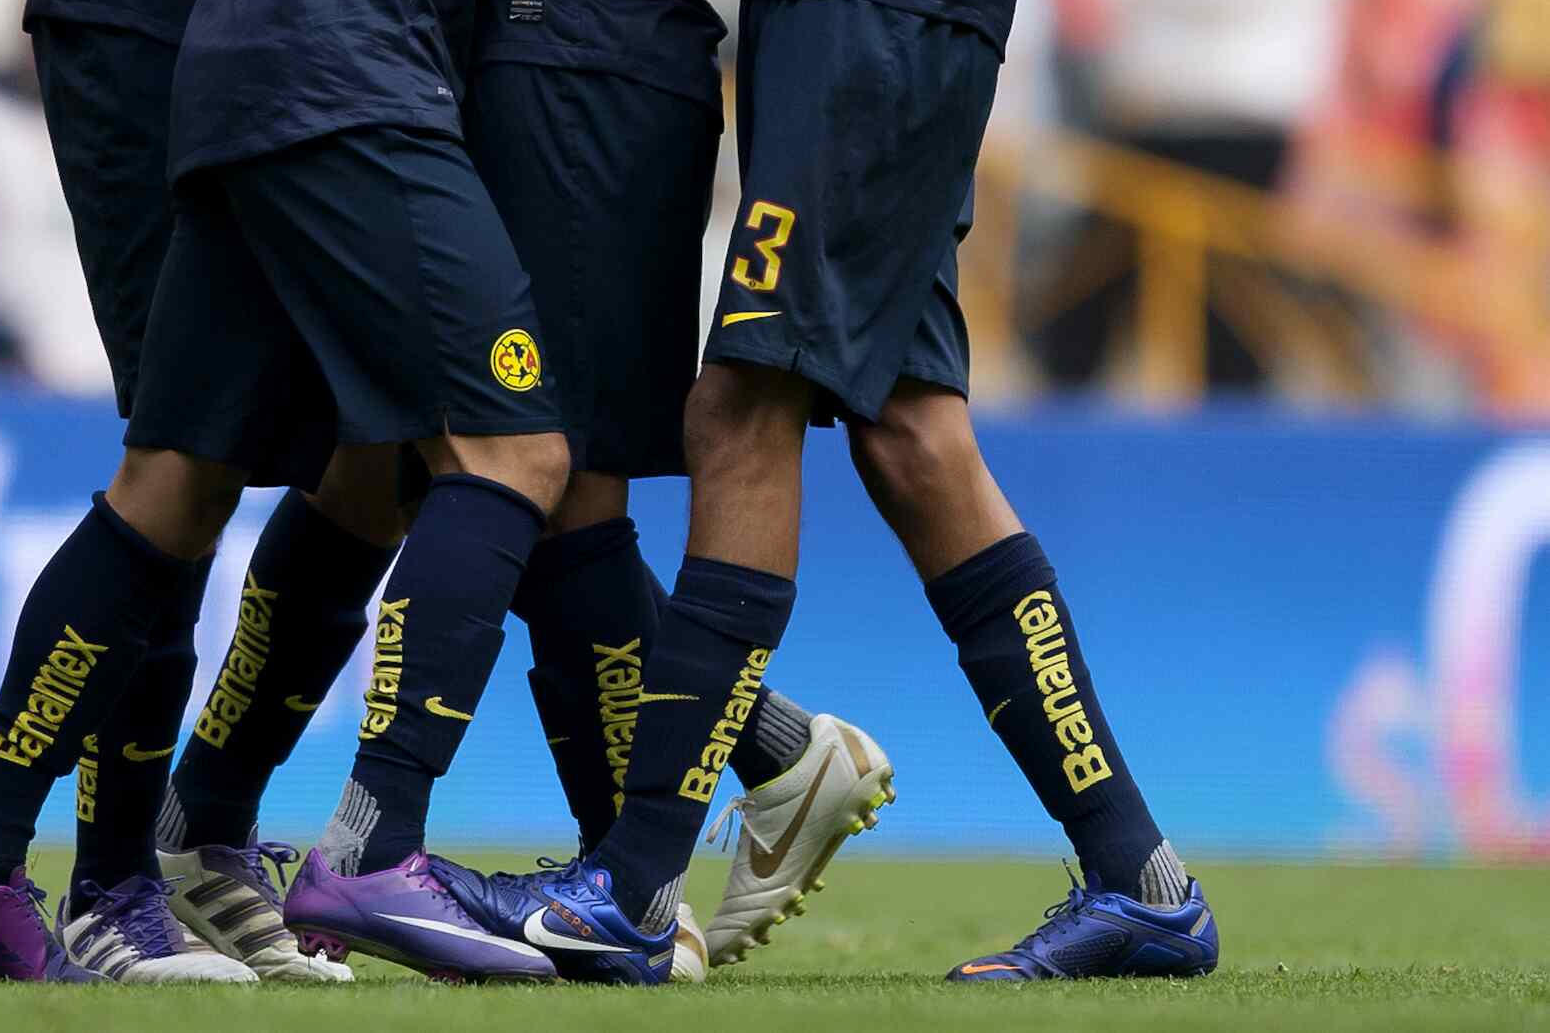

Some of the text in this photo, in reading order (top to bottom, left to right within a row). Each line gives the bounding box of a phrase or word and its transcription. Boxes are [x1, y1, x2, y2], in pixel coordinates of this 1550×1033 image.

[730, 200, 797, 293] 3
[194, 567, 279, 749] Banamex
[359, 597, 411, 741] anamex
[592, 637, 644, 818] namex
[677, 648, 772, 804] Baname
